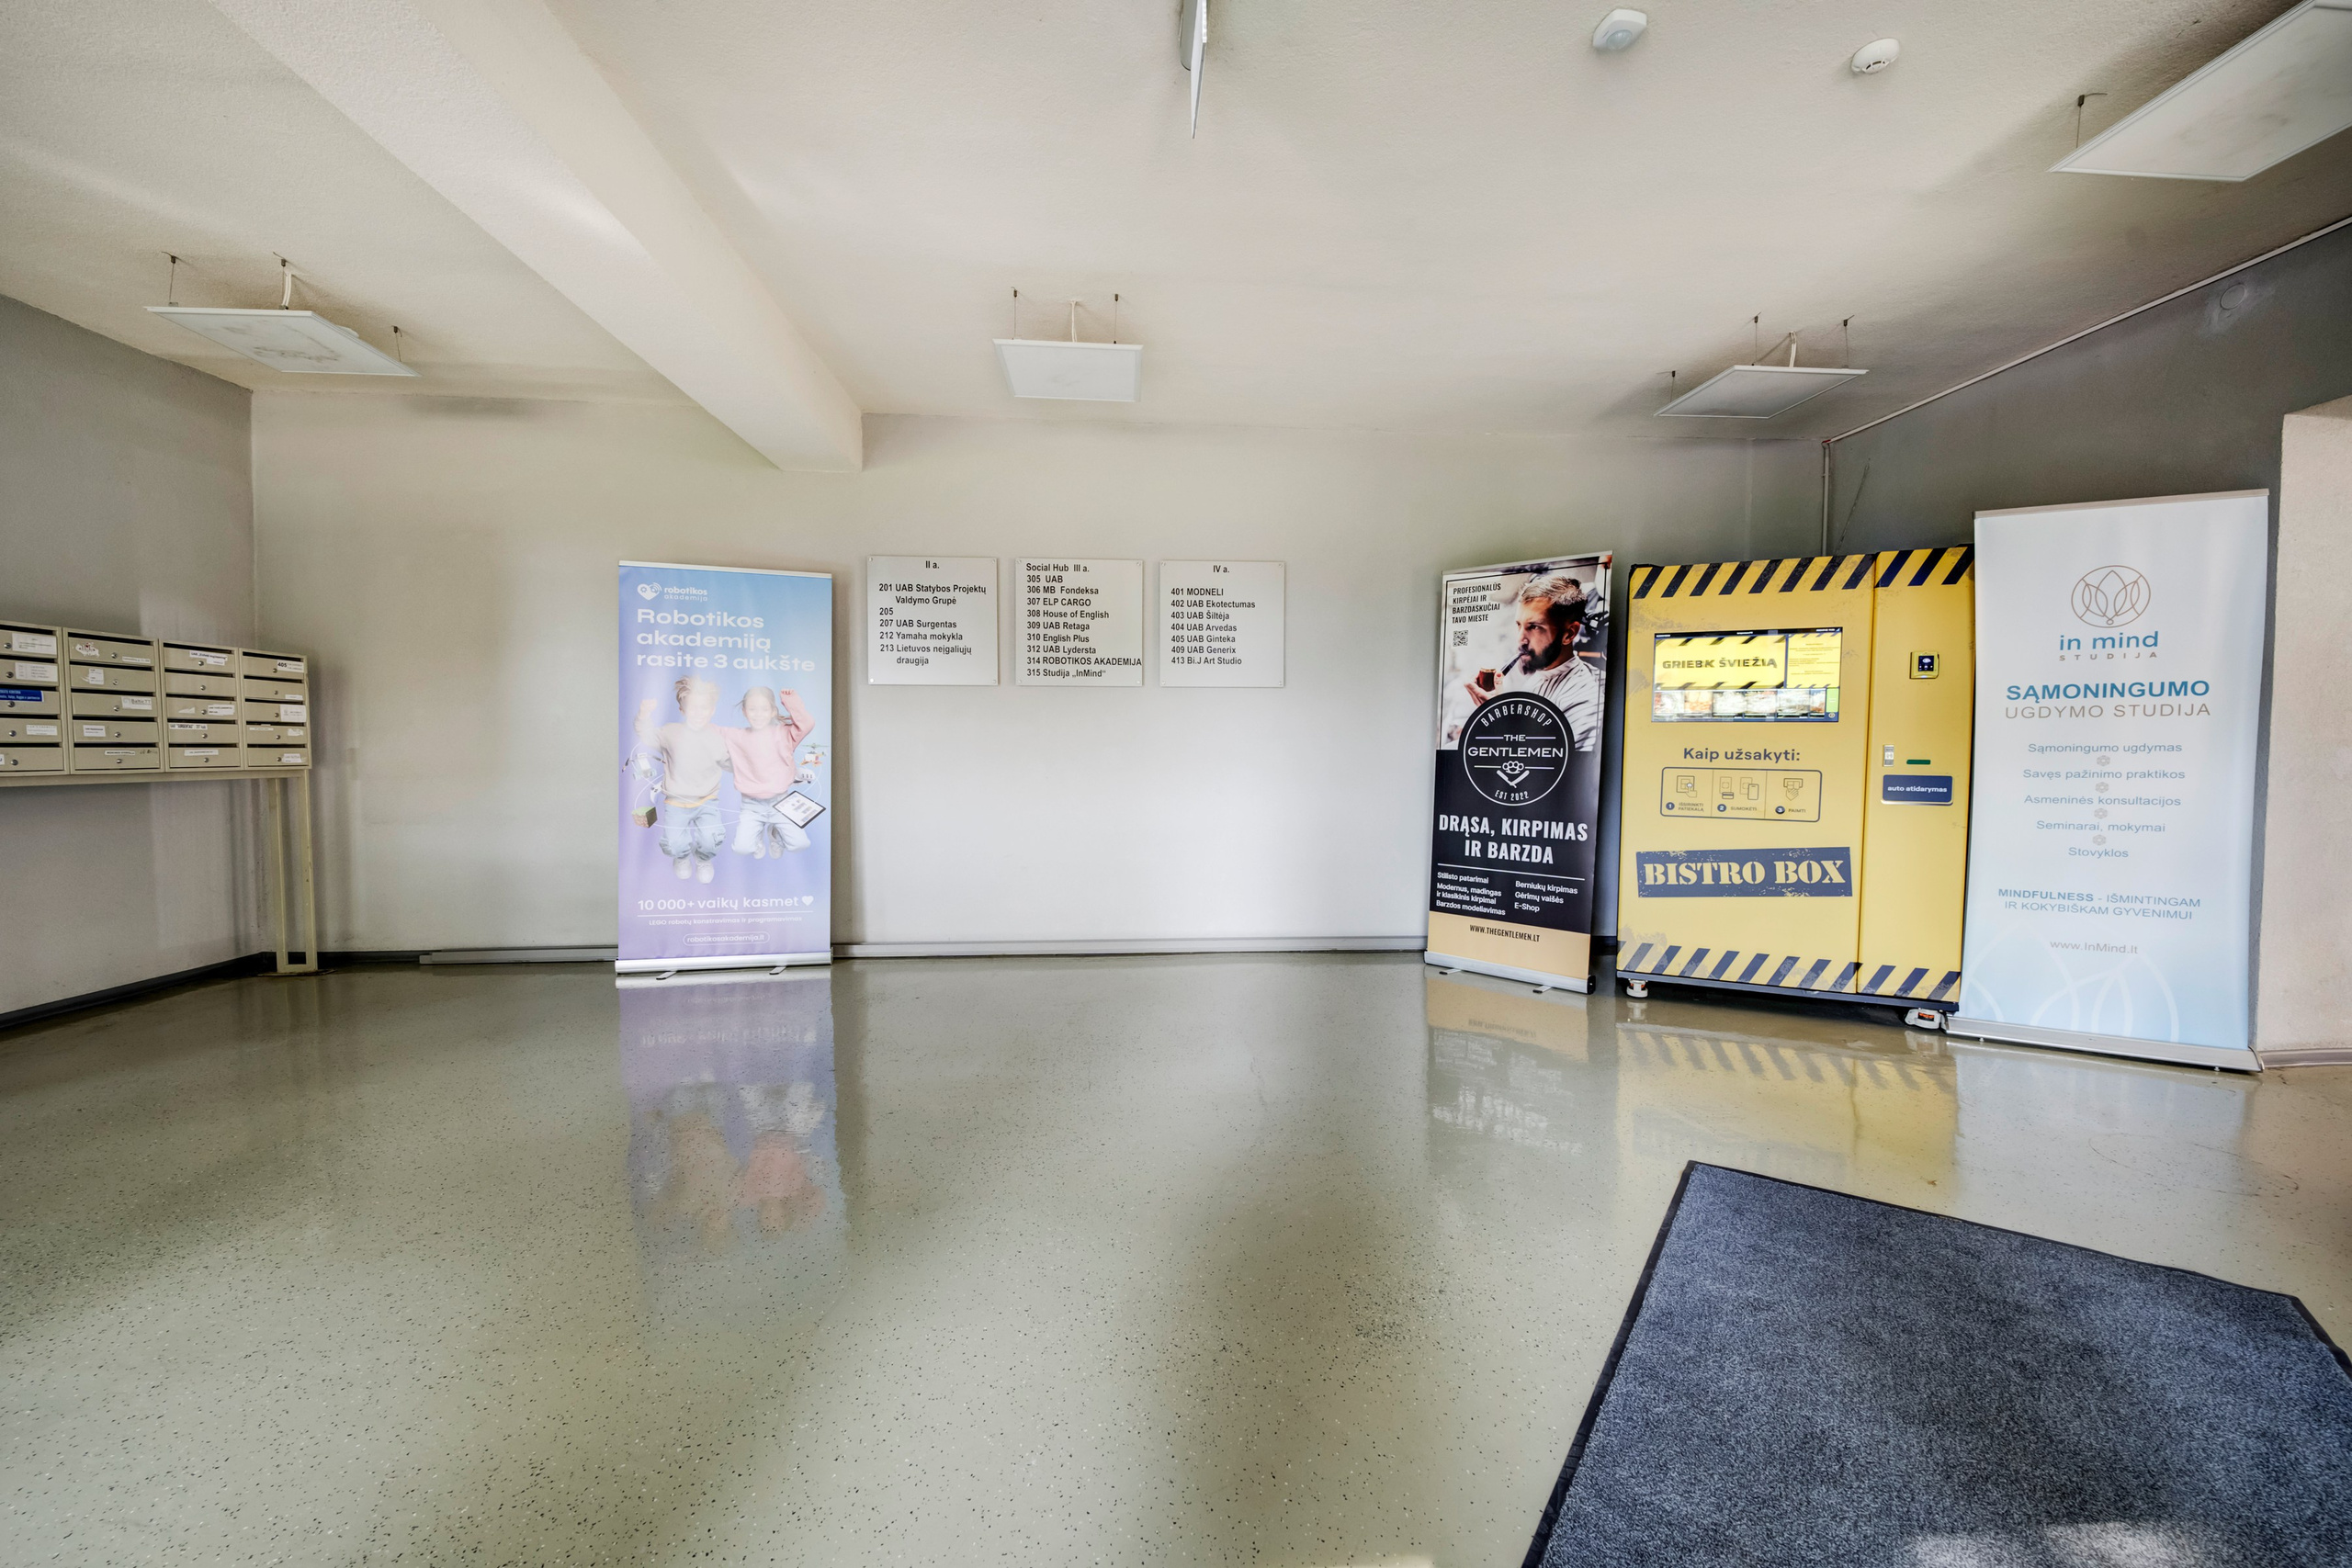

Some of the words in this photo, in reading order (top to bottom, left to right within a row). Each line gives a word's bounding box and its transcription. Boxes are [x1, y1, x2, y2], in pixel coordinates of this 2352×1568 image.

[925, 560, 931, 569] II
[1026, 563, 1050, 571] Social
[1053, 563, 1069, 571] Hub
[1213, 565, 1221, 573] IV
[1027, 575, 1041, 583] 305
[1045, 575, 1063, 583] UAB
[664, 586, 707, 595] robotikos
[879, 583, 893, 592] 201
[895, 583, 913, 592] UAB
[915, 584, 951, 593] Statybos
[953, 585, 987, 594] Projektų
[1060, 586, 1099, 594] Fondeksa
[1186, 588, 1224, 596] MODNELI
[663, 594, 707, 603] akademija
[895, 596, 930, 605] Valdymo
[932, 596, 956, 605] Grupė
[1061, 598, 1091, 606] CARGO
[1206, 600, 1255, 608] Ekotectumas
[1453, 595, 1478, 604] KIRPĖJAI
[879, 607, 893, 615] 205
[1027, 609, 1041, 617] 308
[1043, 610, 1068, 618] House
[1069, 610, 1078, 618] of
[1080, 610, 1109, 620] English
[1452, 603, 1500, 615] BARZDASKUČIAI
[637, 608, 764, 628] Robotikos
[1170, 611, 1184, 619] 403
[1186, 611, 1204, 619] UAB
[1206, 610, 1229, 621] Šiltėja
[1467, 615, 1488, 623] MIESTE
[879, 619, 893, 627] 207
[896, 619, 914, 627] UAB
[916, 620, 957, 629] Surgentas
[1027, 621, 1041, 629] 309
[1062, 622, 1090, 632] Retaga
[1170, 623, 1184, 631] 404
[1186, 623, 1204, 631] UAB
[637, 630, 771, 653] akademiją
[879, 631, 894, 639] 212
[896, 632, 927, 640] Yamaha
[929, 632, 963, 642] mokykla
[1027, 633, 1041, 641] 310
[1043, 634, 1071, 643] English
[1073, 635, 1090, 643] Plus
[1170, 635, 1184, 643] 405
[1186, 635, 1204, 643] UAB
[1206, 635, 1236, 643] Ginteka
[2059, 635, 2081, 651] in
[2092, 630, 2159, 649] mind
[880, 644, 894, 652] 213
[1027, 645, 1041, 653] 312
[1043, 645, 1060, 653] UAB
[1062, 646, 1096, 655] Lydersta
[1186, 646, 1204, 654] UAB
[1206, 646, 1236, 654] Generix
[637, 652, 708, 668] rasite
[713, 654, 728, 669] 3
[732, 655, 815, 671] aukšte
[896, 657, 929, 666] draugija
[1043, 657, 1091, 665] ROBOTIKOS
[1094, 658, 1141, 666] AKADEMIJA
[1216, 657, 1242, 665] Studio
[2059, 651, 2157, 661] STUDIJA
[1043, 669, 1069, 678] Studija
[2006, 680, 2210, 704] SĄMONINGUMO
[1480, 704, 1552, 727] BARBERSHOP
[2006, 705, 2104, 719] UGDYMO
[2113, 703, 2211, 717] STUDIJA
[1467, 747, 1564, 758] GENTLEMEN
[2028, 743, 2119, 754] Sąmoningumo
[2122, 743, 2182, 754] ugdymas
[1683, 747, 1719, 762] Kaip
[1724, 748, 1801, 763] užsakyti:
[2023, 769, 2062, 780] Savęs
[2065, 769, 2122, 781] pažinimo
[2126, 770, 2185, 781] praktikos
[1495, 789, 1508, 800] EST
[1510, 791, 1530, 801] 2022
[2024, 795, 2094, 805] Asmeninės
[2098, 796, 2181, 807] konsultacijos
[1439, 814, 1495, 838] DRĄSA,
[1501, 818, 1588, 841] KIRPIMAS
[2036, 820, 2103, 832] Seminarai,
[2108, 823, 2165, 834] mokymai
[1464, 840, 1482, 858] IR
[1487, 842, 1554, 864] BARZDA
[2067, 847, 2129, 859] Stovyklos
[1437, 872, 1458, 881] Stilisto
[1459, 874, 1489, 884] patarimai
[1644, 861, 1766, 886] BISTRO
[1773, 860, 1846, 884] BOX
[1437, 883, 1469, 893] Modernus,
[1470, 887, 1502, 897] madingas
[1515, 881, 1546, 892] Berniukų
[1547, 885, 1578, 895] kirpimas
[638, 899, 654, 910] 10
[697, 897, 739, 910] vaikų
[743, 897, 798, 908] kasmet
[1442, 891, 1470, 901] klasikinis
[1471, 895, 1497, 905] kirpimai
[1514, 892, 1540, 903] Gėrimų
[1541, 896, 1564, 904] vaišės
[1998, 889, 2094, 902] MINDFULNESS
[2107, 893, 2200, 908] IŠMINTINGAM
[1436, 900, 1461, 909] Barzdos
[1462, 904, 1506, 916] modeliavimas
[1514, 902, 1540, 913] E-Shop
[2005, 901, 2017, 909] IR
[2021, 902, 2109, 915] KOKYBIŠKAM
[2112, 908, 2192, 919] GYVENIMUI
[693, 917, 741, 925] konstravimas
[748, 916, 802, 924] programavimas
[686, 934, 764, 943] robotikosakademija.lt
[1469, 924, 1540, 942] WWW.THEGENTLEMEN.LT
[2050, 941, 2138, 954] www.InMind.lt
